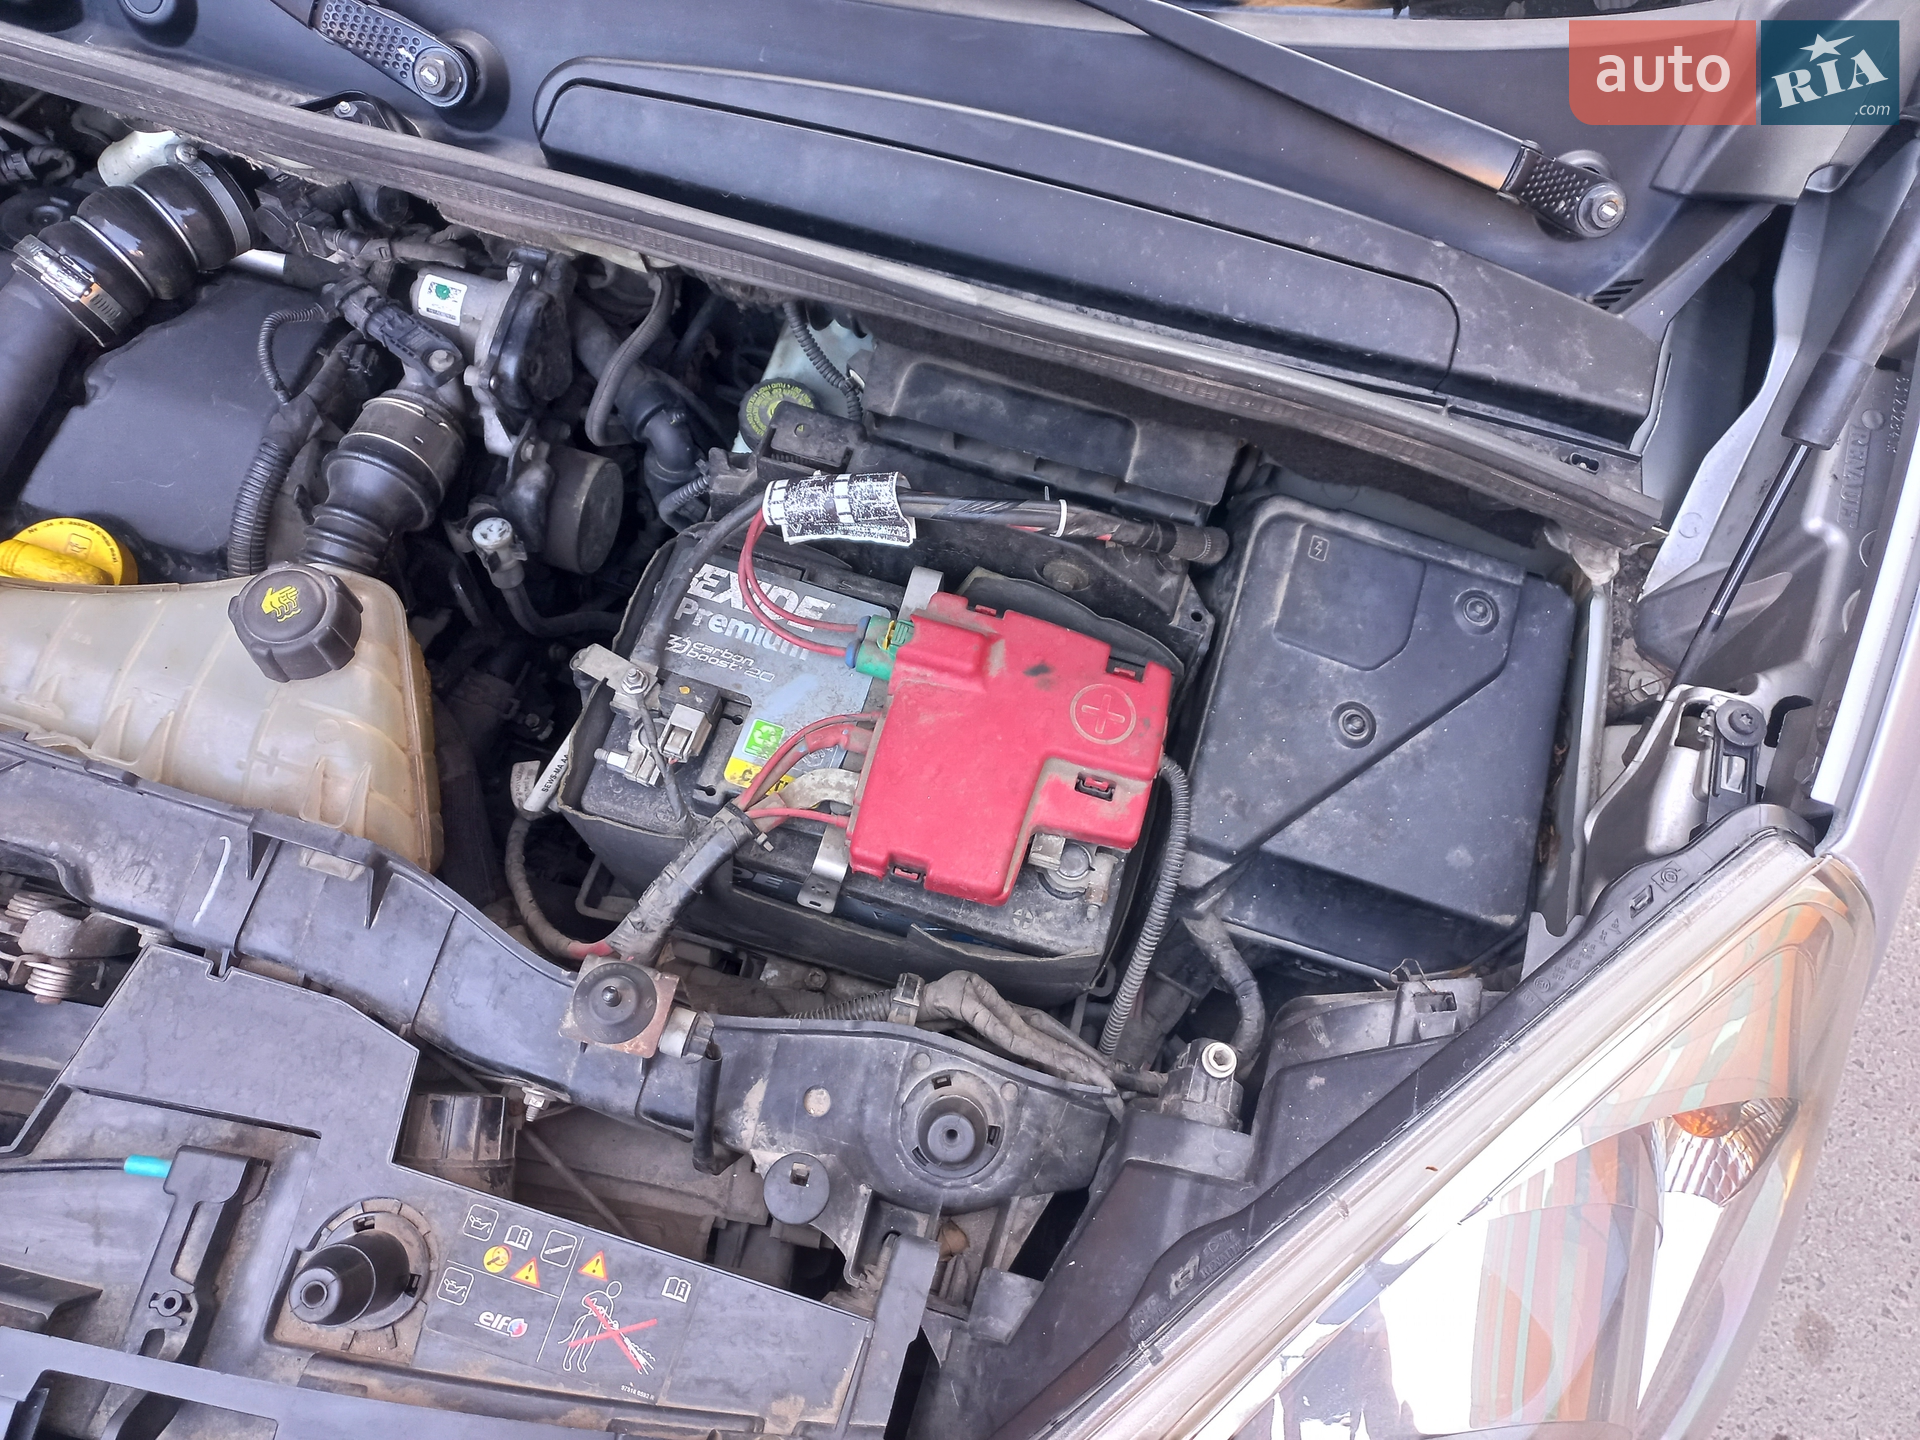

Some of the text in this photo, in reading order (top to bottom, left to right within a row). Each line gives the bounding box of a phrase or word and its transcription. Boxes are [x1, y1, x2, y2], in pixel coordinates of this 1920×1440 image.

[1837, 424, 1871, 529] RENAULT
[673, 596, 810, 661] Premium
[686, 648, 739, 671] boost
[692, 641, 755, 667] carbon
[541, 764, 564, 793] SEWS-MA
[478, 1311, 512, 1330] elf
